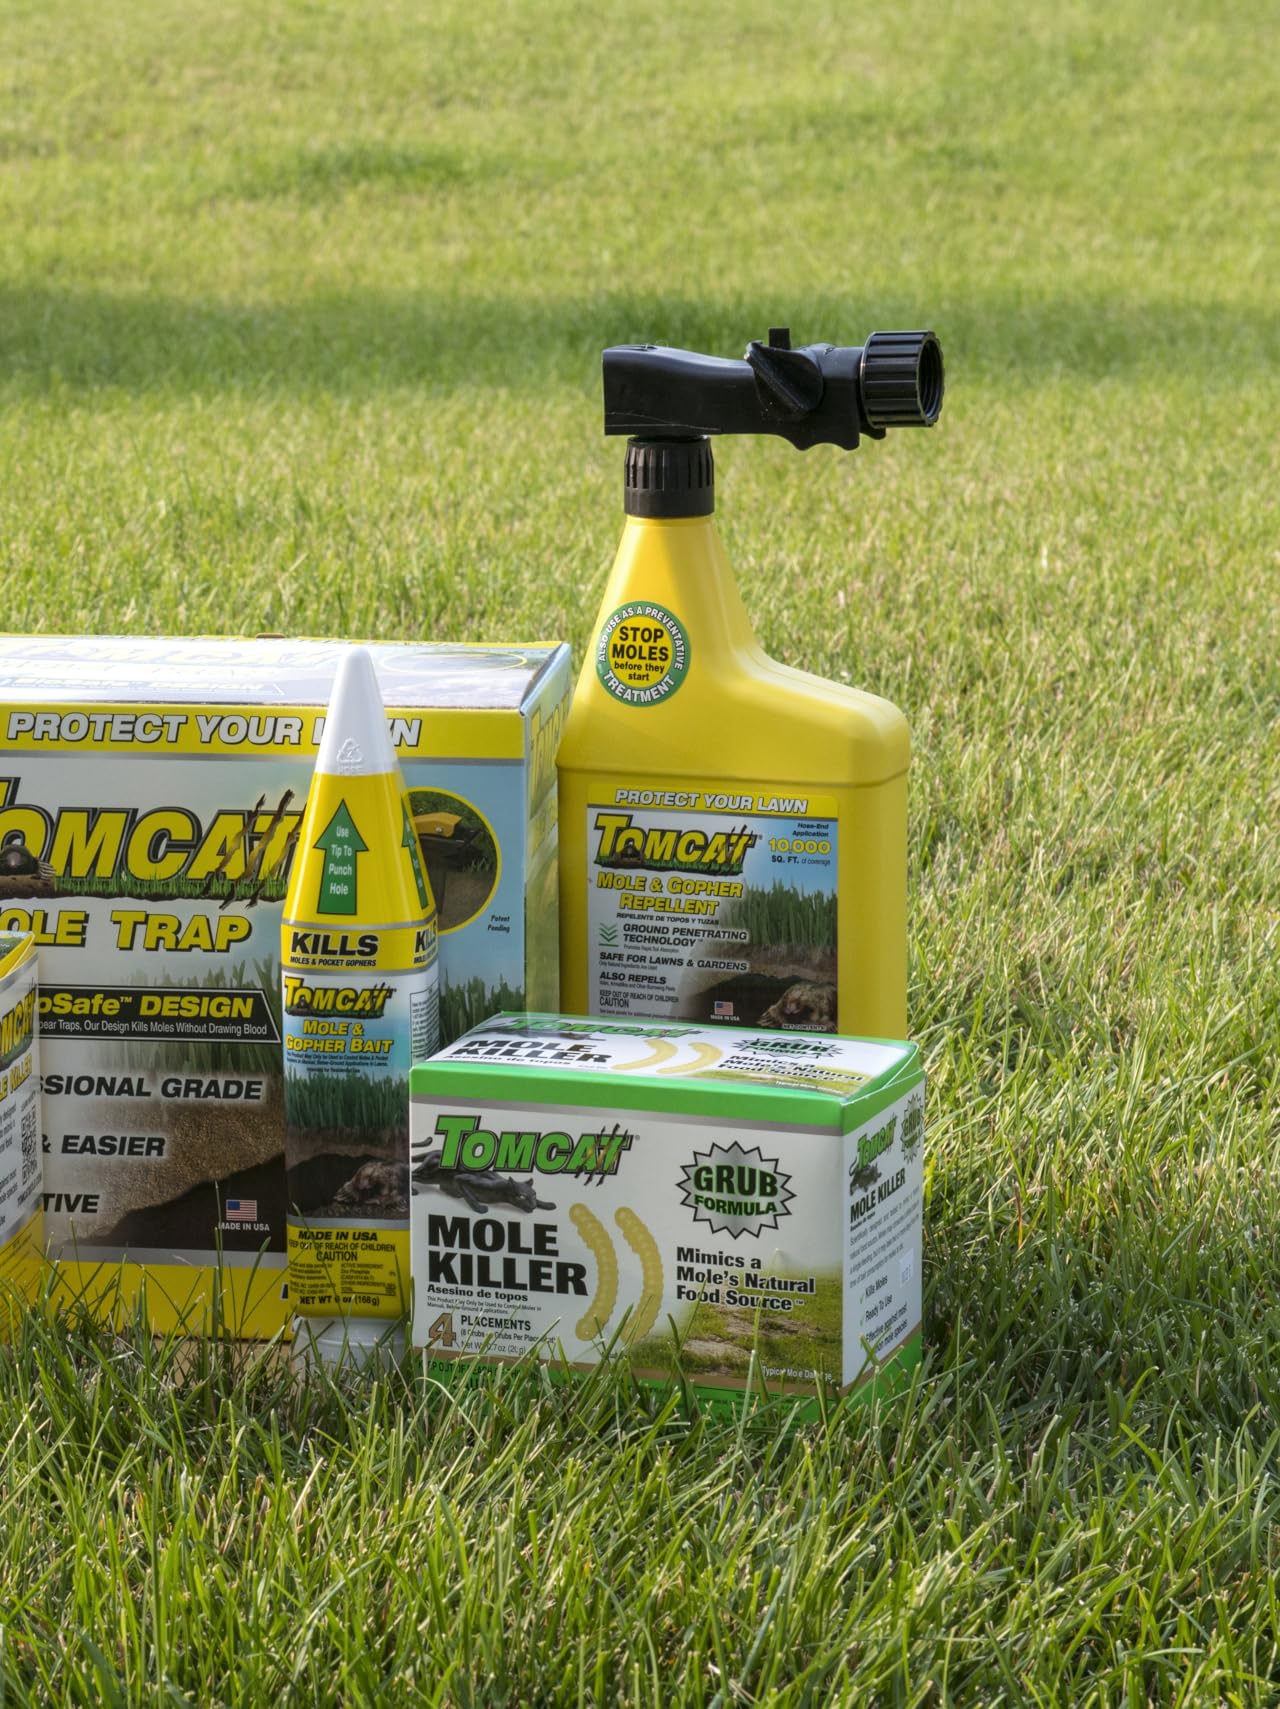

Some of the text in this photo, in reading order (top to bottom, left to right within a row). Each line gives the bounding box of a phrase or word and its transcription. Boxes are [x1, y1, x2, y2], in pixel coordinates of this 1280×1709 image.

[598, 606, 685, 670] ALSO USE AS PREVENTATIVE
[618, 625, 665, 643] STOP
[612, 643, 669, 662] MOLES
[614, 660, 665, 674] before they
[628, 672, 650, 681] start
[603, 669, 675, 703] TREATMENT
[6, 711, 302, 746] PROTECT YOUR
[614, 789, 808, 814] PROTECT YOUR LAWN
[335, 825, 350, 838] Use
[593, 813, 758, 865] TOMCAT
[330, 844, 353, 858] Tip To
[328, 863, 353, 876] Punch
[329, 882, 349, 895] Hole
[596, 871, 744, 898] MOLE & GOPHER
[619, 892, 720, 916] REPELLENT
[616, 912, 654, 921] REPELENTE
[111, 910, 253, 953] TRAP
[623, 923, 748, 941] GROUND PENETRATING
[291, 930, 379, 957] KILLS
[290, 955, 377, 967] MOLES POCKET GOPHERS
[599, 951, 625, 961] SAFE
[626, 953, 647, 963] FOR
[649, 955, 684, 967] LAWNS
[697, 959, 748, 971] GARDENS
[599, 971, 667, 985] ALSO REPELS
[284, 975, 393, 1015] TOMCAT
[599, 996, 630, 1009] CAUTION
[38, 992, 254, 1019] oSafe DESIGN
[58, 1019, 268, 1036] Traps, Our Design Kills Moles Without Drawing Blood
[303, 1019, 365, 1036] MOLE &
[285, 1036, 395, 1054] GOPHER BAIT
[462, 1039, 597, 1053] MOLE
[451, 1047, 613, 1064] KILLER
[160, 1078, 264, 1100] GRADE
[61, 1134, 167, 1157] EASIER
[434, 1114, 634, 1176] TOMCAT
[693, 1164, 778, 1197] GRUB
[850, 1167, 906, 1224] MOLE KILLER
[694, 1194, 778, 1217] FORMULA
[218, 1221, 271, 1232] MADE IN USA
[298, 1230, 378, 1242] MADE IN USA
[428, 1213, 560, 1258] MOLE
[316, 1251, 358, 1262] CAUTION
[676, 1246, 762, 1270] Mimics a
[428, 1250, 589, 1297] KILLER
[676, 1265, 816, 1294] Mole's Natural
[427, 1284, 529, 1302] Asesino de topos
[676, 1285, 720, 1304] Food
[428, 1312, 532, 1348] 4 PLACEMENTS
